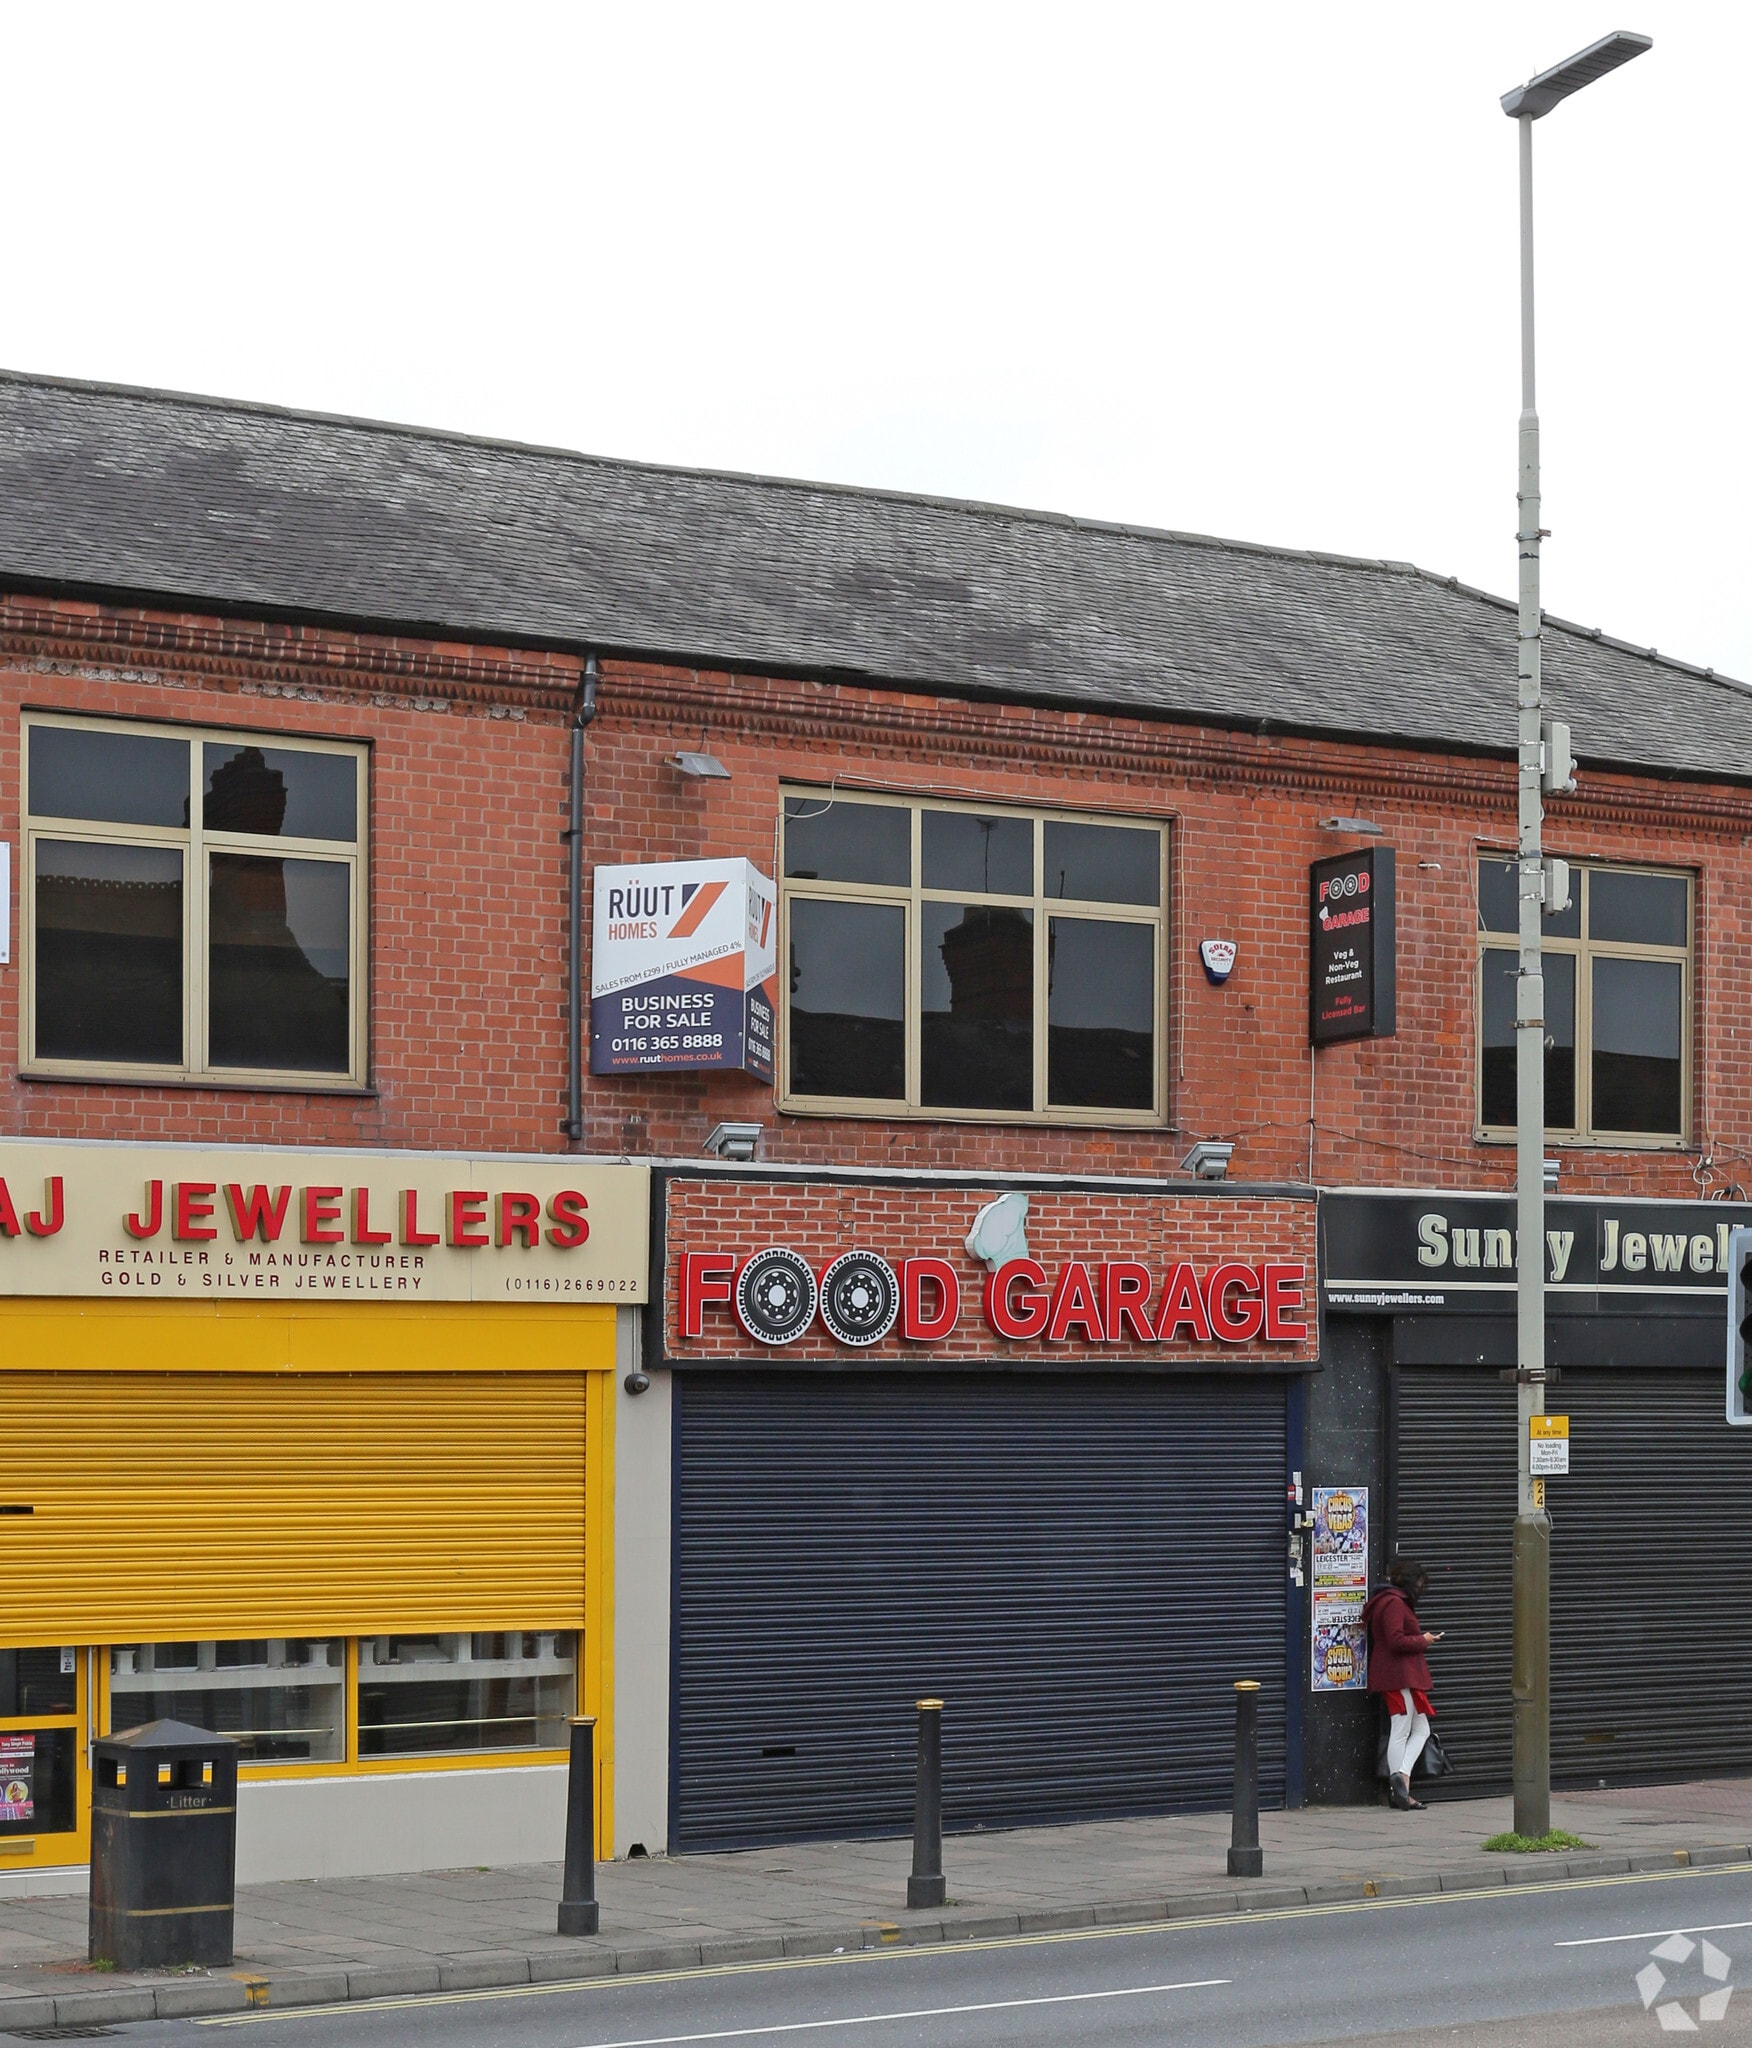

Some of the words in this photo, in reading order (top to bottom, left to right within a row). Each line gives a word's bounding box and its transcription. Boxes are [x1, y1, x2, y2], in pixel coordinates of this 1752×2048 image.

[1319, 871, 1371, 903] FOOD
[1322, 907, 1370, 931] GARAGE
[608, 922, 658, 941] HOMES
[1333, 952, 1348, 960] Veg
[1348, 948, 1355, 957] &
[595, 980, 619, 994] SALES
[620, 973, 642, 987] FROM
[643, 967, 661, 979] £299
[667, 958, 689, 971] FULLY
[690, 946, 729, 965] MANAGED
[730, 941, 742, 950] 4%
[1328, 960, 1360, 973] Non-Veg
[1325, 971, 1363, 985] Restaurant
[621, 993, 714, 1012] BUSINESS
[1321, 1007, 1353, 1020] Licensed
[1353, 1004, 1366, 1014] Bar
[623, 1015, 662, 1030] FOR
[666, 1013, 712, 1029] SALE
[611, 1035, 648, 1052] 0116
[650, 1034, 680, 1050] 365
[683, 1033, 723, 1049] 8888
[612, 1052, 723, 1066] www.ruuthomes.co.uk
[122, 1178, 592, 1249] JEWELLERS
[1417, 1213, 1575, 1283] Suny
[1599, 1218, 1745, 1275] Jewel
[98, 1249, 210, 1265] RETAILER
[224, 1253, 235, 1266] &
[248, 1253, 426, 1269] MANUFACTURER
[101, 1271, 163, 1288] GOLD
[176, 1273, 187, 1287] &
[202, 1272, 282, 1289] SILVER
[294, 1275, 424, 1291] JEWELLERY
[505, 1276, 640, 1293] (0116)2669022
[678, 1246, 961, 1348] FOOD
[983, 1256, 1309, 1343] GARAGE
[1327, 1292, 1445, 1307] www.sunnyjewellers.com
[1545, 1442, 1562, 1450] loading
[1328, 1497, 1353, 1512] CIRCUS
[1328, 1513, 1353, 1530] VEGAS
[1316, 1554, 1348, 1563] LEICESTER
[1331, 1615, 1362, 1624] EICESTER
[170, 1796, 207, 1809] Litter
